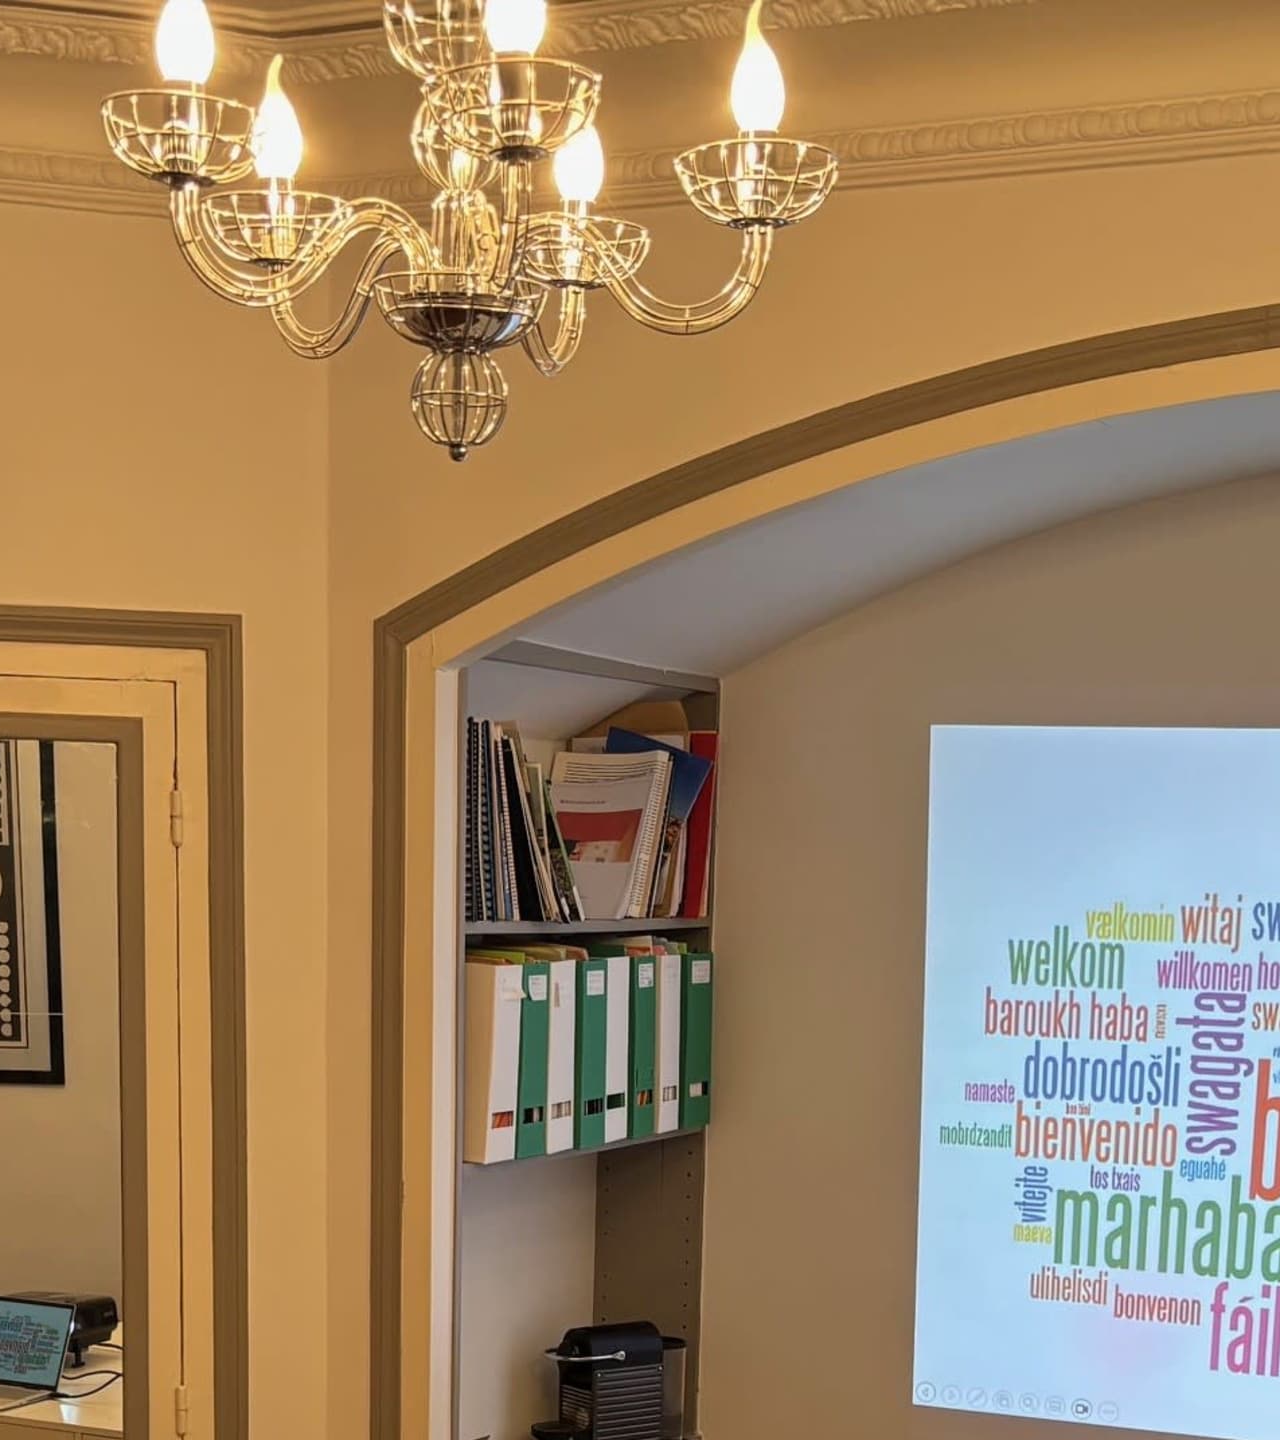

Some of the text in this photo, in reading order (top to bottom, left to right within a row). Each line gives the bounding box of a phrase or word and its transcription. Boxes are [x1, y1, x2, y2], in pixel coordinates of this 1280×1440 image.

[1086, 902, 1175, 942] vælkomin
[1180, 893, 1244, 953] witaj
[1008, 925, 1124, 990] welkom
[1157, 950, 1253, 993] willkomen
[984, 986, 1082, 1039] baroukh
[1088, 990, 1149, 1043] haba
[964, 1078, 1016, 1104] namaste
[1024, 1039, 1182, 1107] dobrodošli
[1175, 991, 1255, 1156] swagata
[1013, 1099, 1178, 1168] bienvenido
[1013, 1223, 1052, 1245] maeva
[1030, 1265, 1109, 1306] ulihelisdi
[1113, 1283, 1202, 1326] bonvenon
